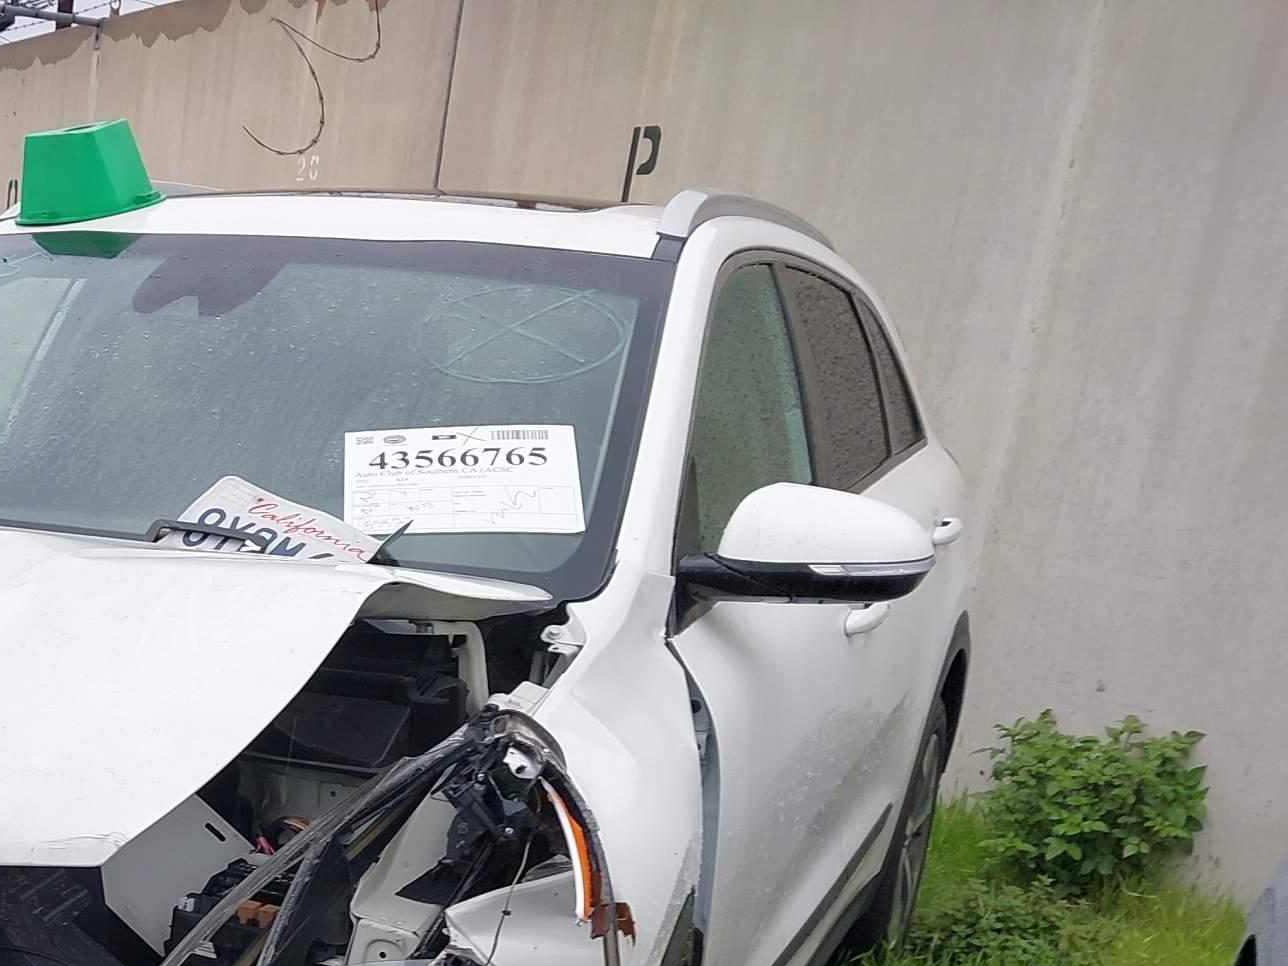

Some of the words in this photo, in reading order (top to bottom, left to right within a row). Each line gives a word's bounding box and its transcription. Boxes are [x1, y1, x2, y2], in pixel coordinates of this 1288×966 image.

[620, 125, 662, 202] P
[368, 446, 548, 470] 43566765
[247, 502, 368, 562] California
